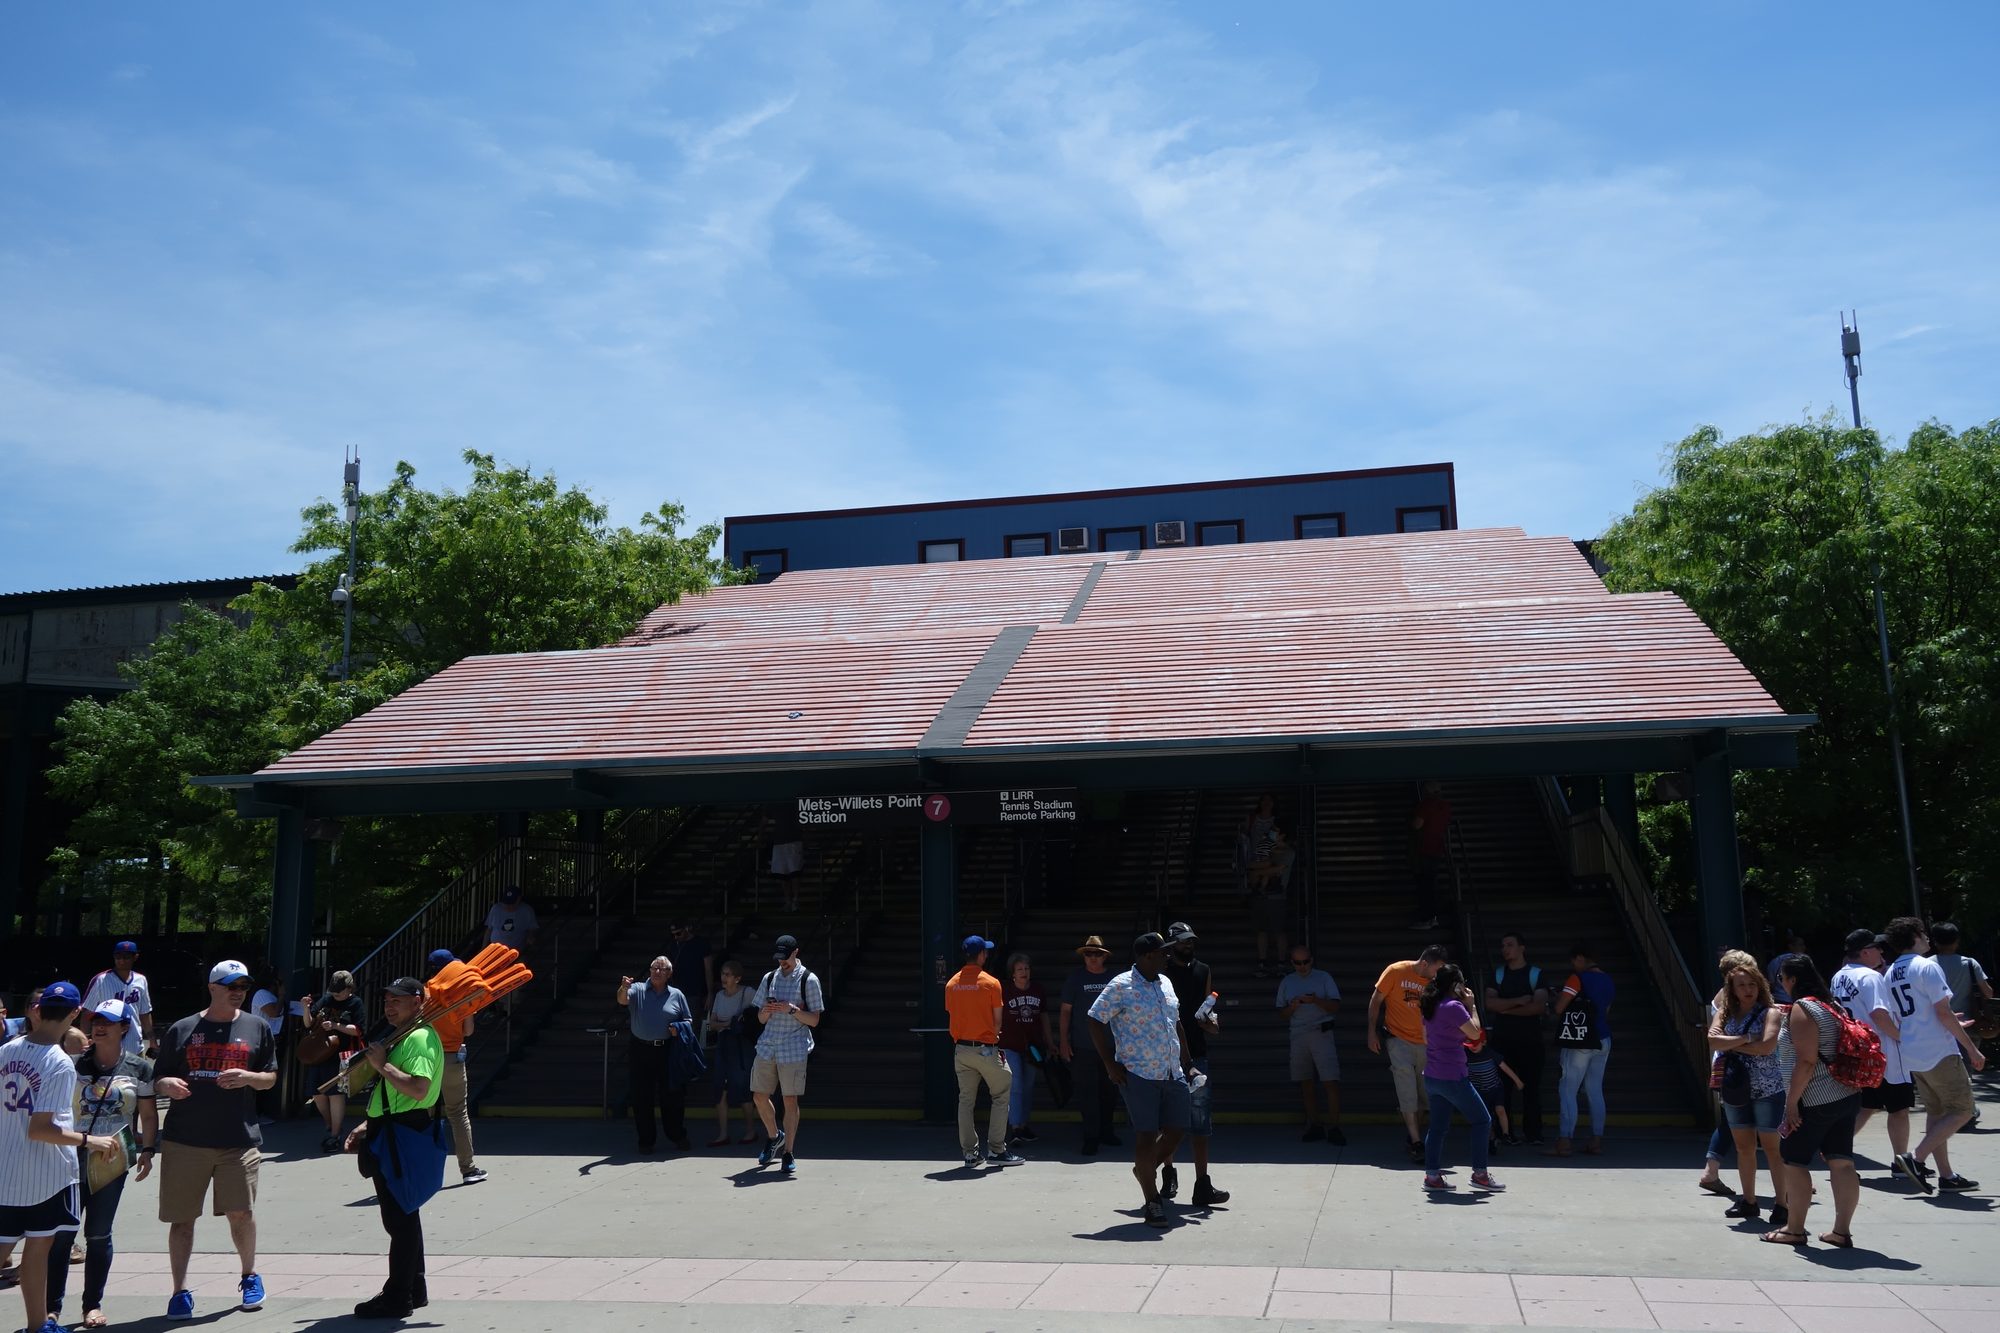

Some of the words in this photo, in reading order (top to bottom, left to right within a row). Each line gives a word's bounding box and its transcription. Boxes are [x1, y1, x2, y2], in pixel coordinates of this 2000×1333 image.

[1012, 791, 1034, 800] LIRR
[798, 796, 883, 811] Mets-Willets
[888, 795, 923, 808] Point
[932, 800, 943, 816] 7
[1000, 801, 1030, 811] Tennis
[1033, 800, 1073, 810] Stadium
[798, 811, 847, 824] Station
[1000, 812, 1037, 821] Remote
[1040, 810, 1076, 820] Parking
[1833, 975, 1859, 999] LANDER
[1891, 983, 1915, 1017] 15
[217, 1048, 249, 1059] EAST
[4, 1081, 34, 1116] 34
